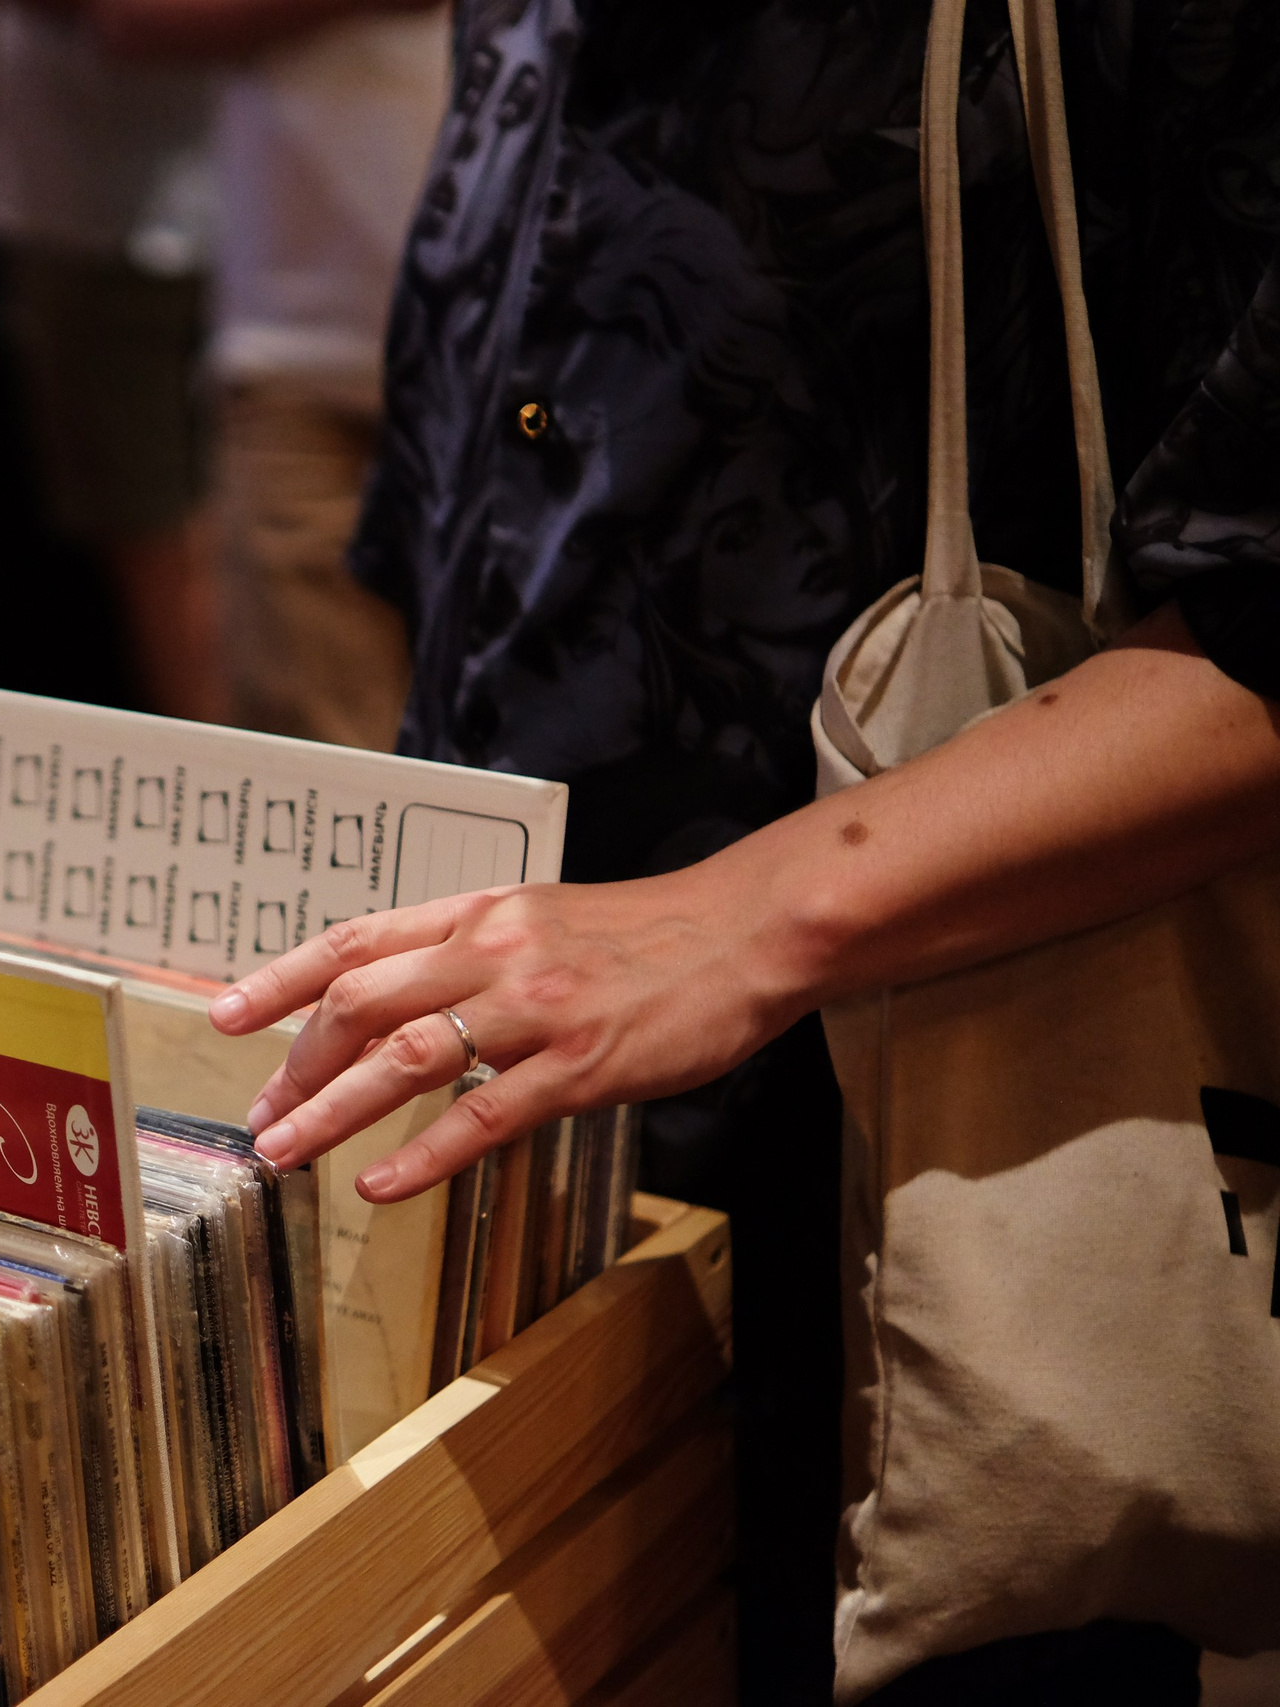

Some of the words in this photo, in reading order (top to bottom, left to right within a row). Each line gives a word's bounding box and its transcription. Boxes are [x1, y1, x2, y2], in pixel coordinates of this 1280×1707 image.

[301, 788, 318, 872] MALEVICH
[46, 1102, 62, 1192] Вдохновляем
[57, 1195, 65, 1211] на
[40, 1480, 49, 1500] THE
[42, 1503, 52, 1539] SOUND
[45, 1542, 54, 1556] OF
[48, 1559, 57, 1586] JAZZ
[121, 1557, 132, 1611] POPULAR
